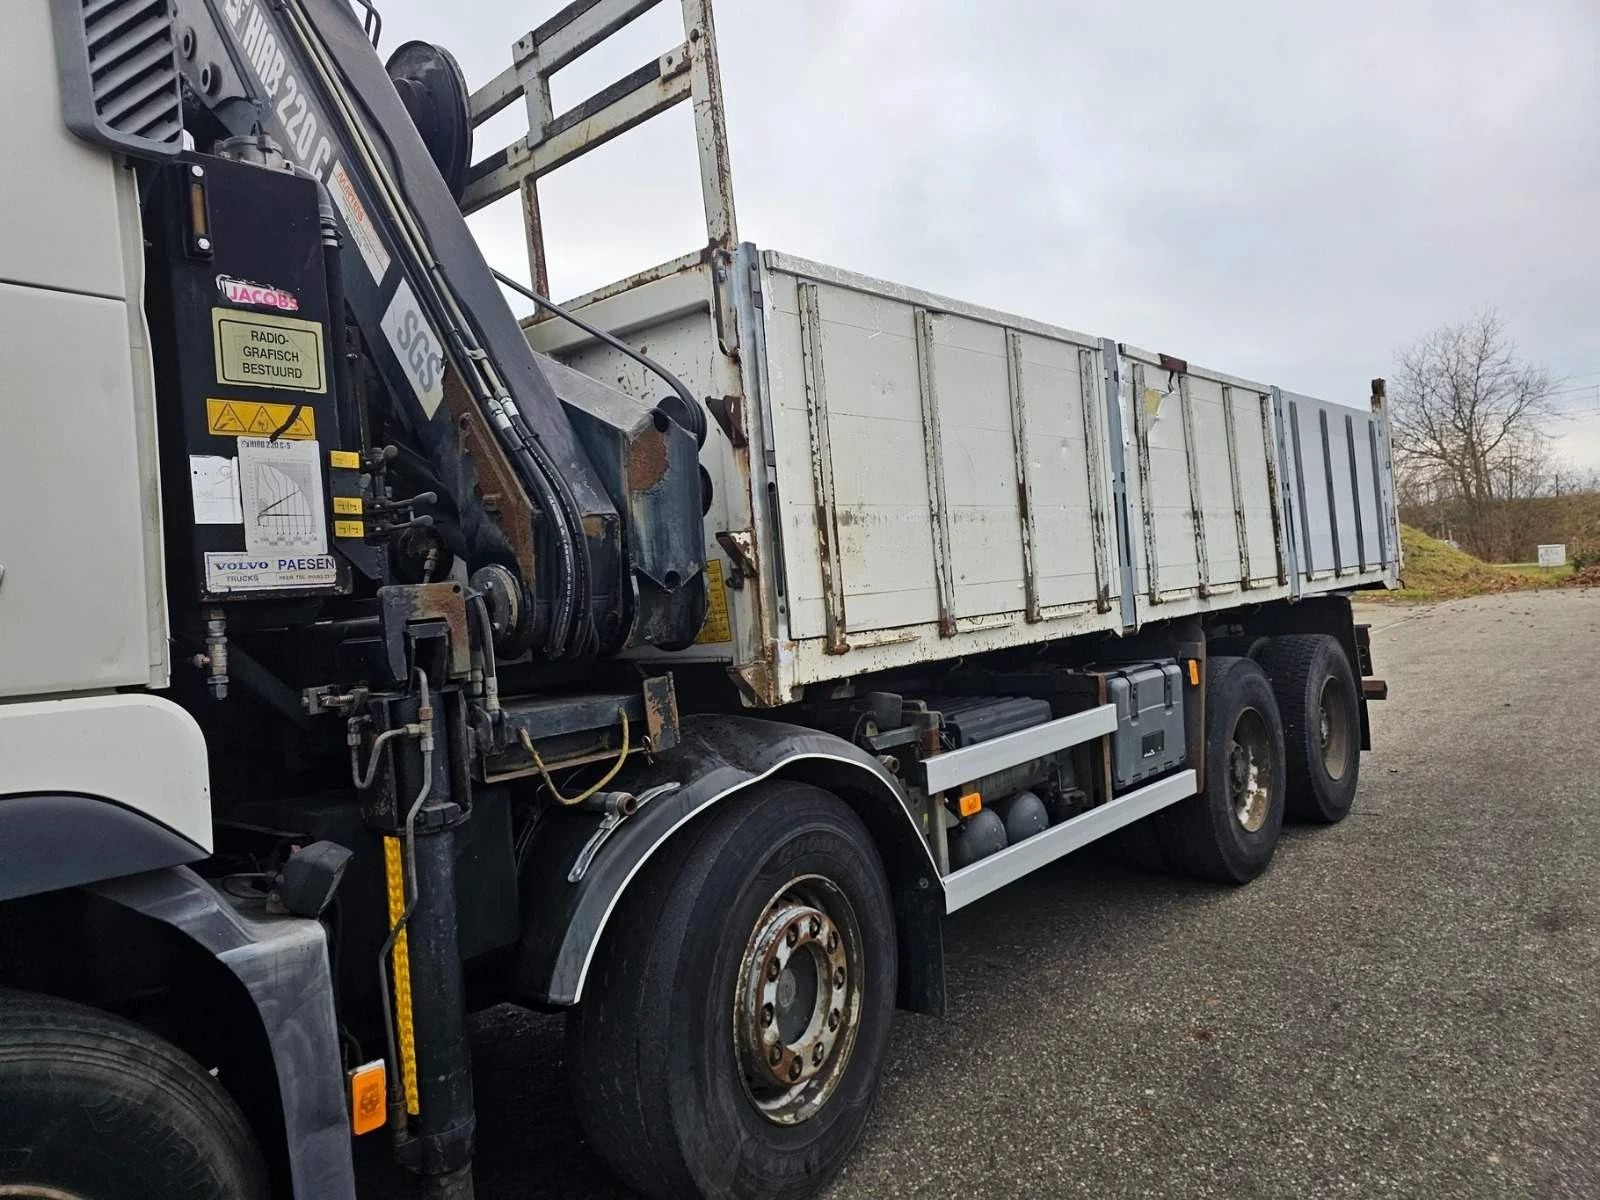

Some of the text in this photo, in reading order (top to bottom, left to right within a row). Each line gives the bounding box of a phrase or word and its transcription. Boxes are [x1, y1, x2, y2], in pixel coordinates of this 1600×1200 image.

[242, 4, 331, 182] HIAB 220 C
[230, 286, 298, 309] JACOBS
[251, 330, 290, 345] RADIO-
[242, 346, 300, 363] GRAFISCH
[397, 309, 441, 393] SGS
[242, 362, 303, 379] BESTUURD
[214, 558, 335, 571] VOLVO PAESEN
[226, 574, 260, 583] TRUCKS
